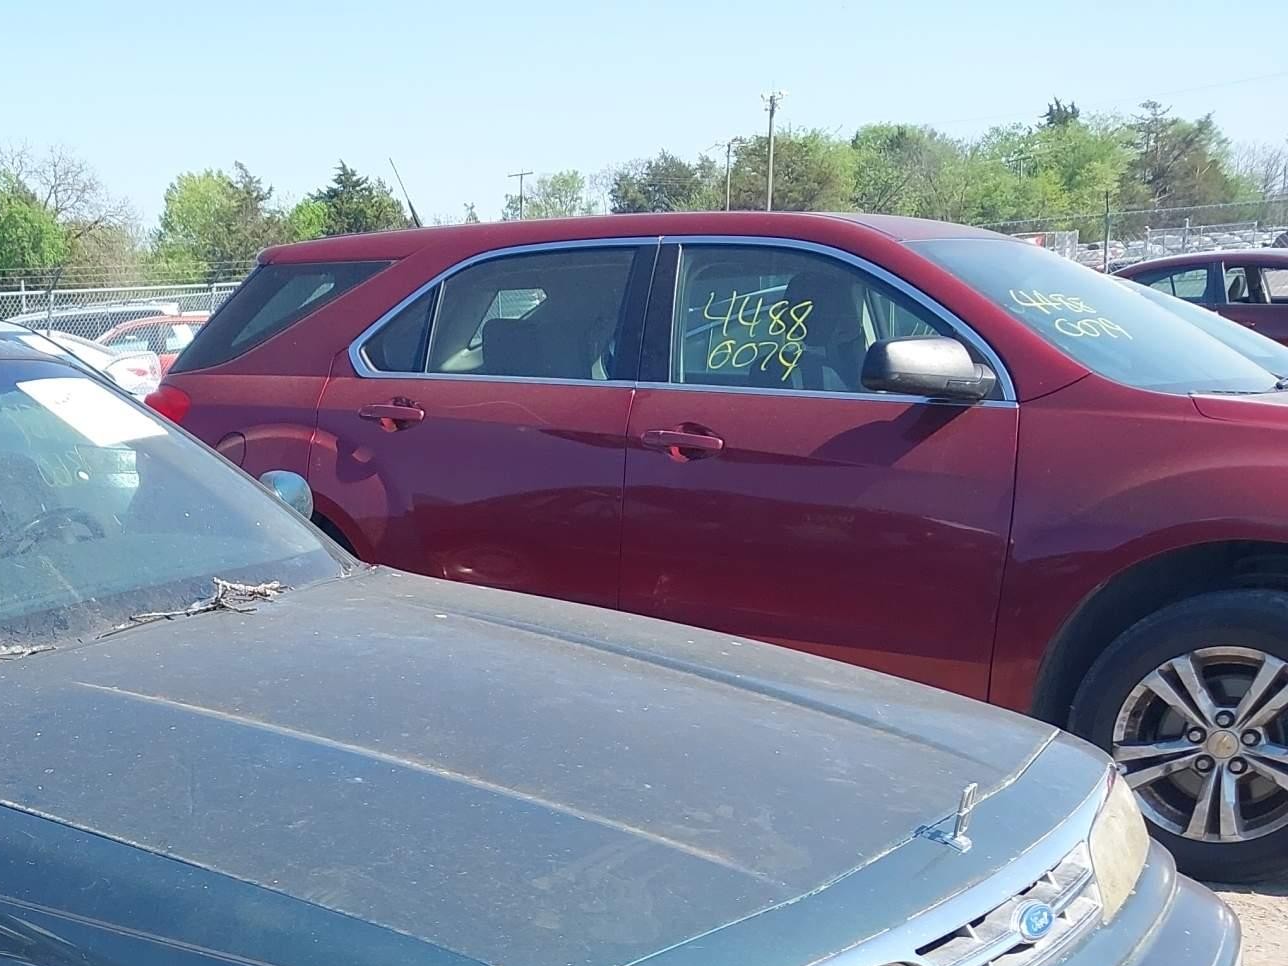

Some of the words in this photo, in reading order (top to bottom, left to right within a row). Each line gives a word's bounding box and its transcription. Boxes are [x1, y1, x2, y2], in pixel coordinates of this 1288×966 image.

[704, 291, 813, 341] 4488
[1008, 289, 1097, 315] 4488
[1055, 317, 1134, 340] 0079
[708, 340, 804, 382] 0079
